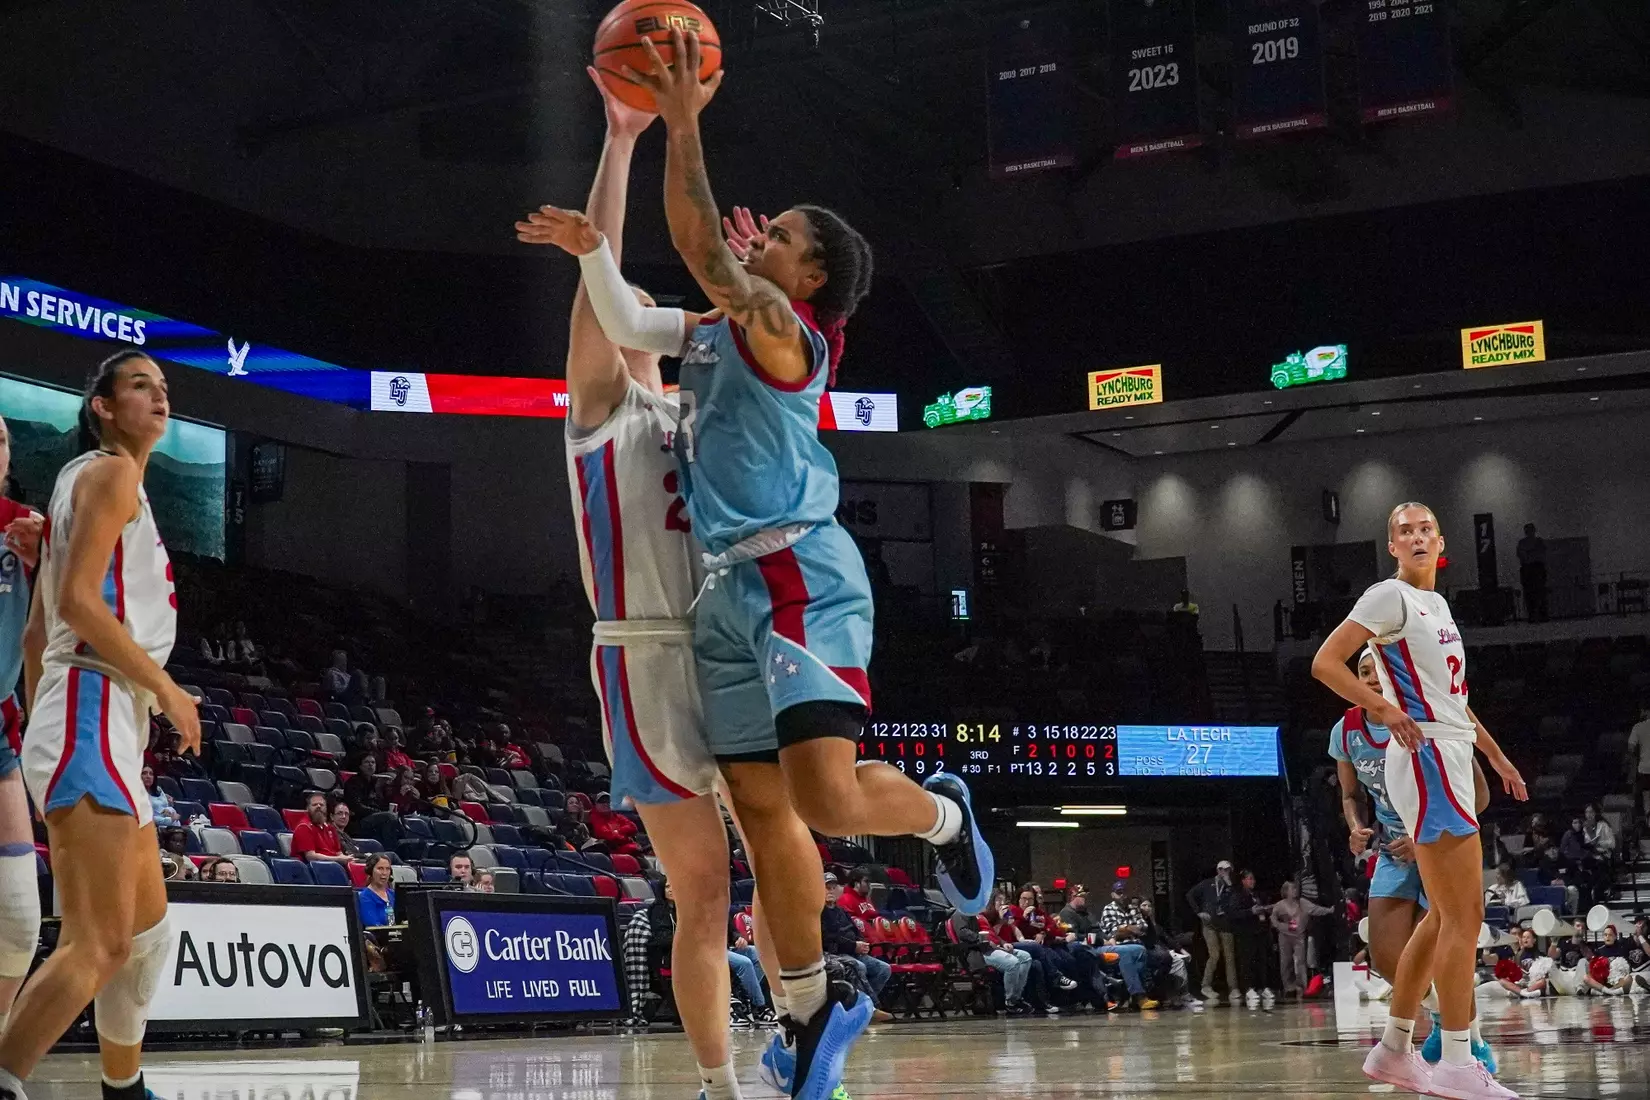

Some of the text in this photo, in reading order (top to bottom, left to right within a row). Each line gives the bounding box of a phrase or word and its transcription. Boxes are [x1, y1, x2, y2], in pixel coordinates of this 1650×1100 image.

[1368, 4, 1433, 22] 2019 2020 2021
[1248, 17, 1300, 35] ROUND OF 32
[1131, 44, 1174, 60] SWEET 16
[1251, 36, 1299, 64] 2019
[999, 63, 1056, 80] 2009 2017 2018
[1128, 62, 1180, 92] 2023
[1398, 102, 1435, 114] BASKETBALL
[1272, 119, 1308, 131] BASKETBALL
[1149, 139, 1184, 151] BASKETBALL
[1023, 159, 1056, 170] BASKETBALL
[0, 282, 146, 345] N SERVICES
[1471, 333, 1534, 354] LYNCHBURG
[1471, 349, 1535, 364] READY MIX
[1096, 376, 1153, 396] LYNCHBURG
[1097, 391, 1153, 406] READY MIX
[1294, 560, 1305, 604] OMEN
[871, 723, 888, 737] 12
[892, 723, 908, 737] 21
[910, 723, 928, 737] 23
[931, 724, 947, 738] 31
[956, 723, 1001, 743] 8:14
[1027, 725, 1037, 738] 3
[1043, 725, 1060, 739] 15
[1062, 726, 1079, 739] 18
[1081, 726, 1098, 740] 22
[1100, 726, 1116, 740] 23
[1191, 728, 1231, 741] TECH
[858, 741, 945, 757] 1 1 1 0 1
[969, 750, 989, 760] 3RD
[1013, 744, 1114, 758] F 2 1 0 0 2
[1186, 744, 1213, 764] 27
[916, 760, 925, 774] 9
[935, 760, 944, 774] 2
[1135, 756, 1164, 765] POSS
[1010, 762, 1115, 776] PT 13 2 2 5 3
[1179, 767, 1212, 776] FOULS
[1153, 857, 1168, 897] MEN
[484, 928, 612, 961] Carter Bank
[174, 931, 350, 989] Autova
[486, 979, 601, 999] LIFE LIVED FULL
